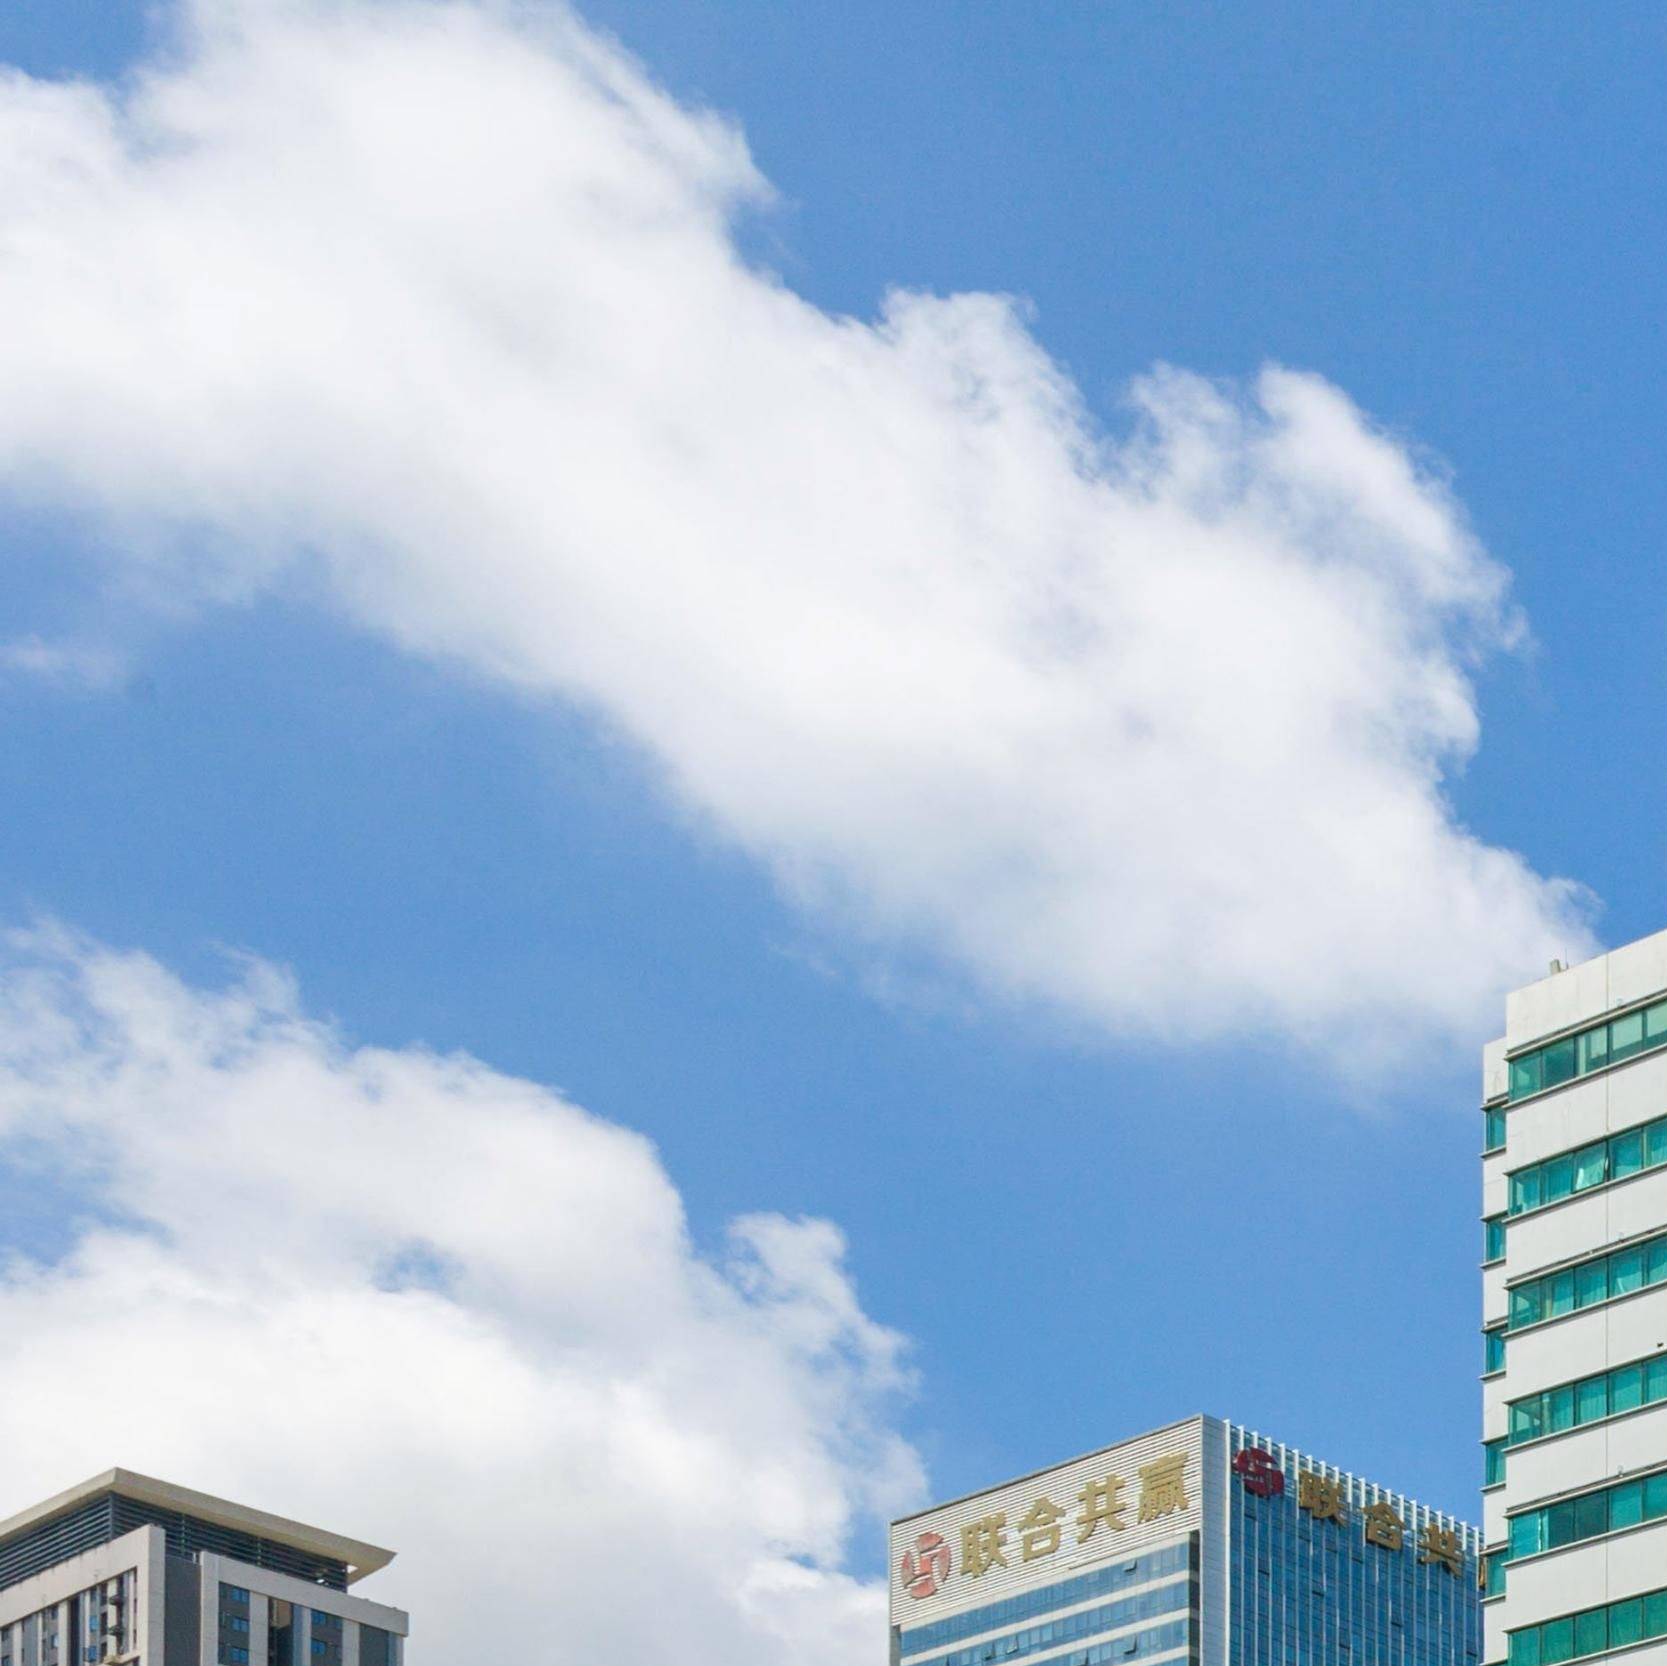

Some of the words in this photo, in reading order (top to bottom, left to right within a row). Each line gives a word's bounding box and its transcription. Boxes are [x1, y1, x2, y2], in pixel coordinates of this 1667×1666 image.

[960, 1452, 1189, 1579] 联合共赢
[1299, 1468, 1485, 1590] 联合共
